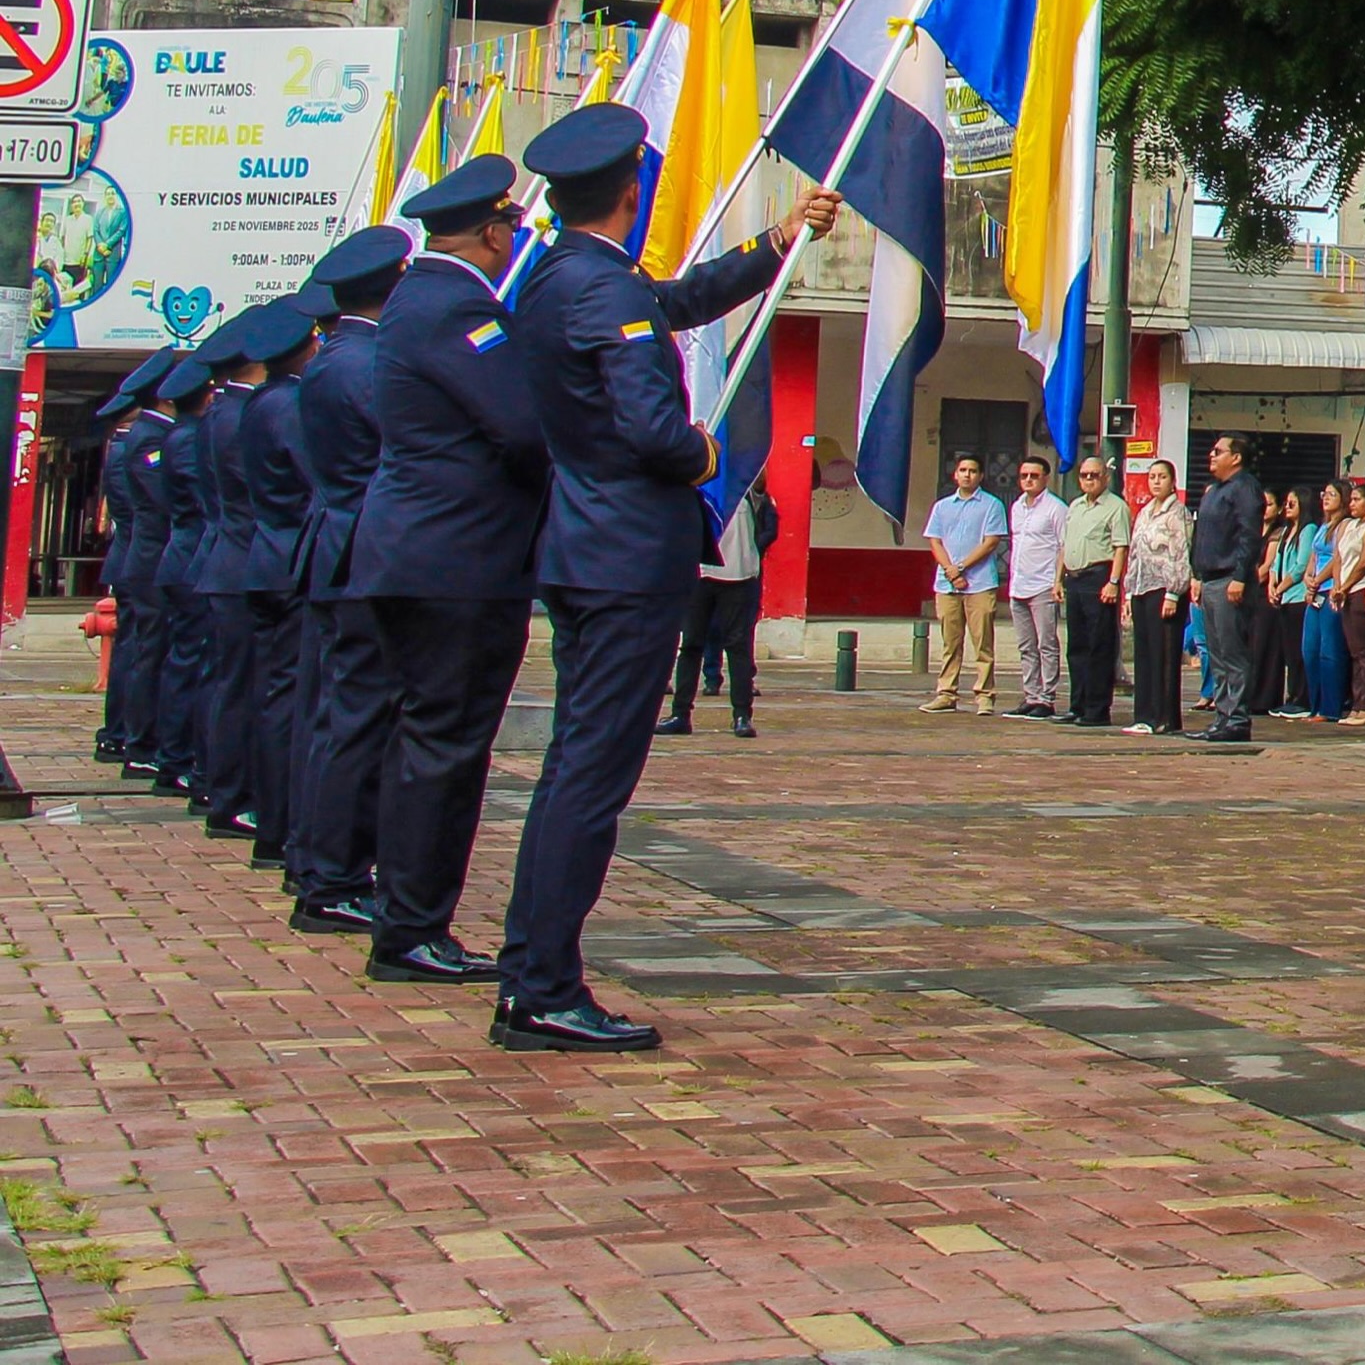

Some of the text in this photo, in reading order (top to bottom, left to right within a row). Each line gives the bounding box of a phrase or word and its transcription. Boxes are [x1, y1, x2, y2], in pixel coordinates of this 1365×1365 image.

[155, 52, 226, 73] DAULE
[283, 46, 370, 113] 205
[167, 83, 256, 97] TE INVITAMOS:
[209, 105, 215, 114] A
[168, 124, 264, 146] FERIA DE
[239, 157, 309, 178] SALUD
[158, 192, 337, 205] Y SERVICIOS MUNICIPALES
[212, 221, 319, 231] 21 DE NOVIEMBRE 2025
[232, 254, 268, 265] 9:00AM
[280, 254, 315, 265] 1:00PM
[255, 281, 298, 290] PLAZA DE
